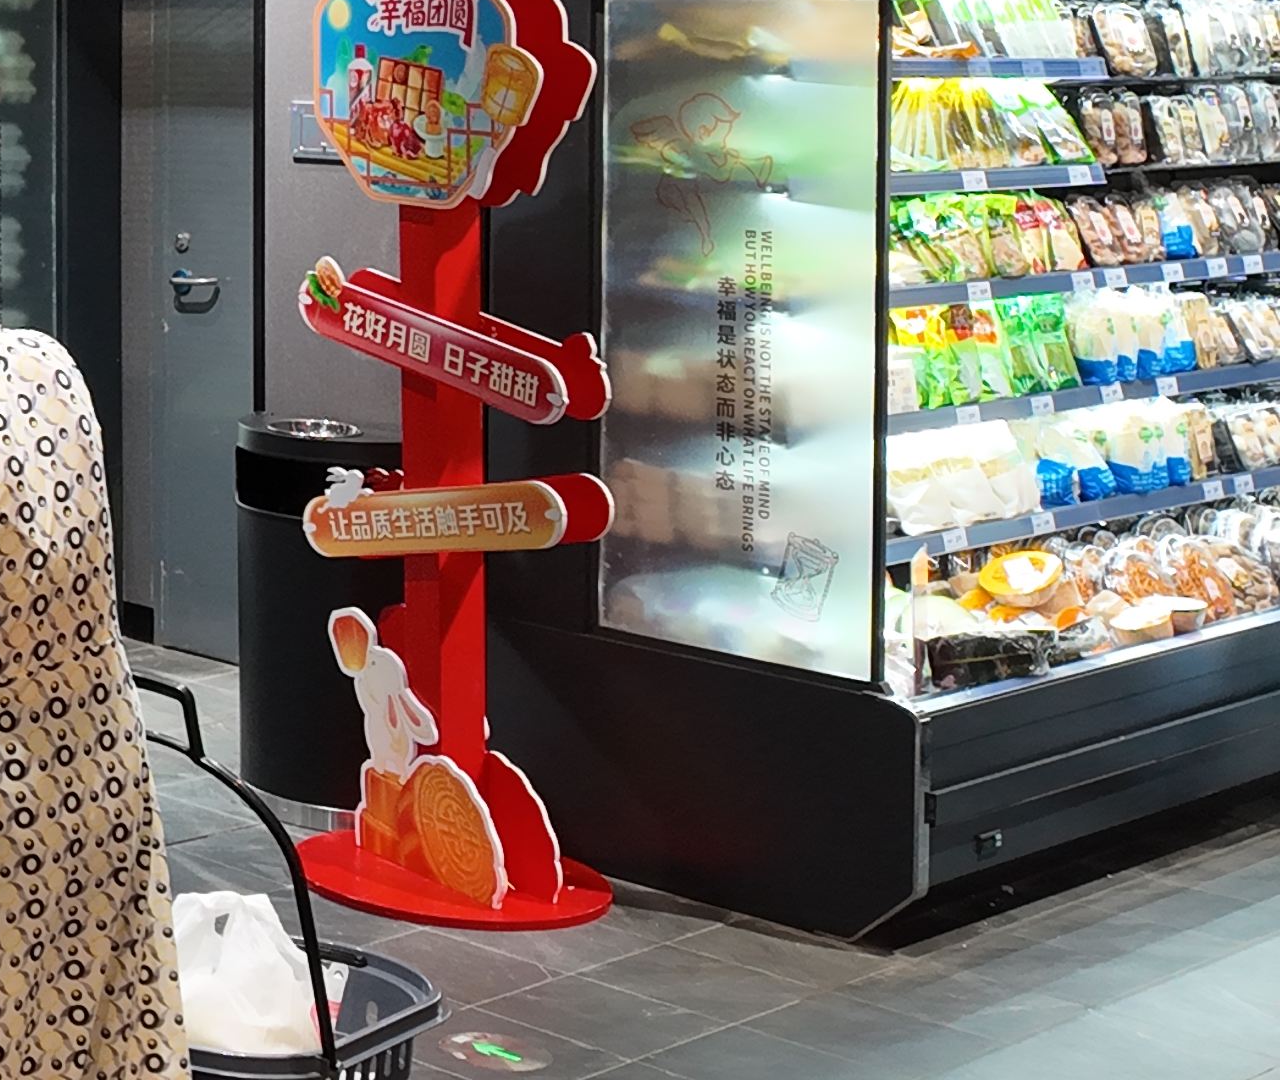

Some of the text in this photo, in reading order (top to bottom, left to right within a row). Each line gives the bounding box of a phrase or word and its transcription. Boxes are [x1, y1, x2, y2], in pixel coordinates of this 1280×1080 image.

[343, 301, 540, 408] 花好月圆 日子甜甜
[759, 340, 771, 369] NOT
[715, 275, 738, 492] 幸福是状态而非心态
[740, 230, 757, 553] BUT HOW YOU REACT ON WHAT LIFE BRINGS
[759, 375, 771, 403] THE
[758, 407, 771, 454] STATE
[758, 457, 770, 476] OF
[328, 500, 532, 542] 让品质生活触手可及
[757, 480, 770, 520] MIND
